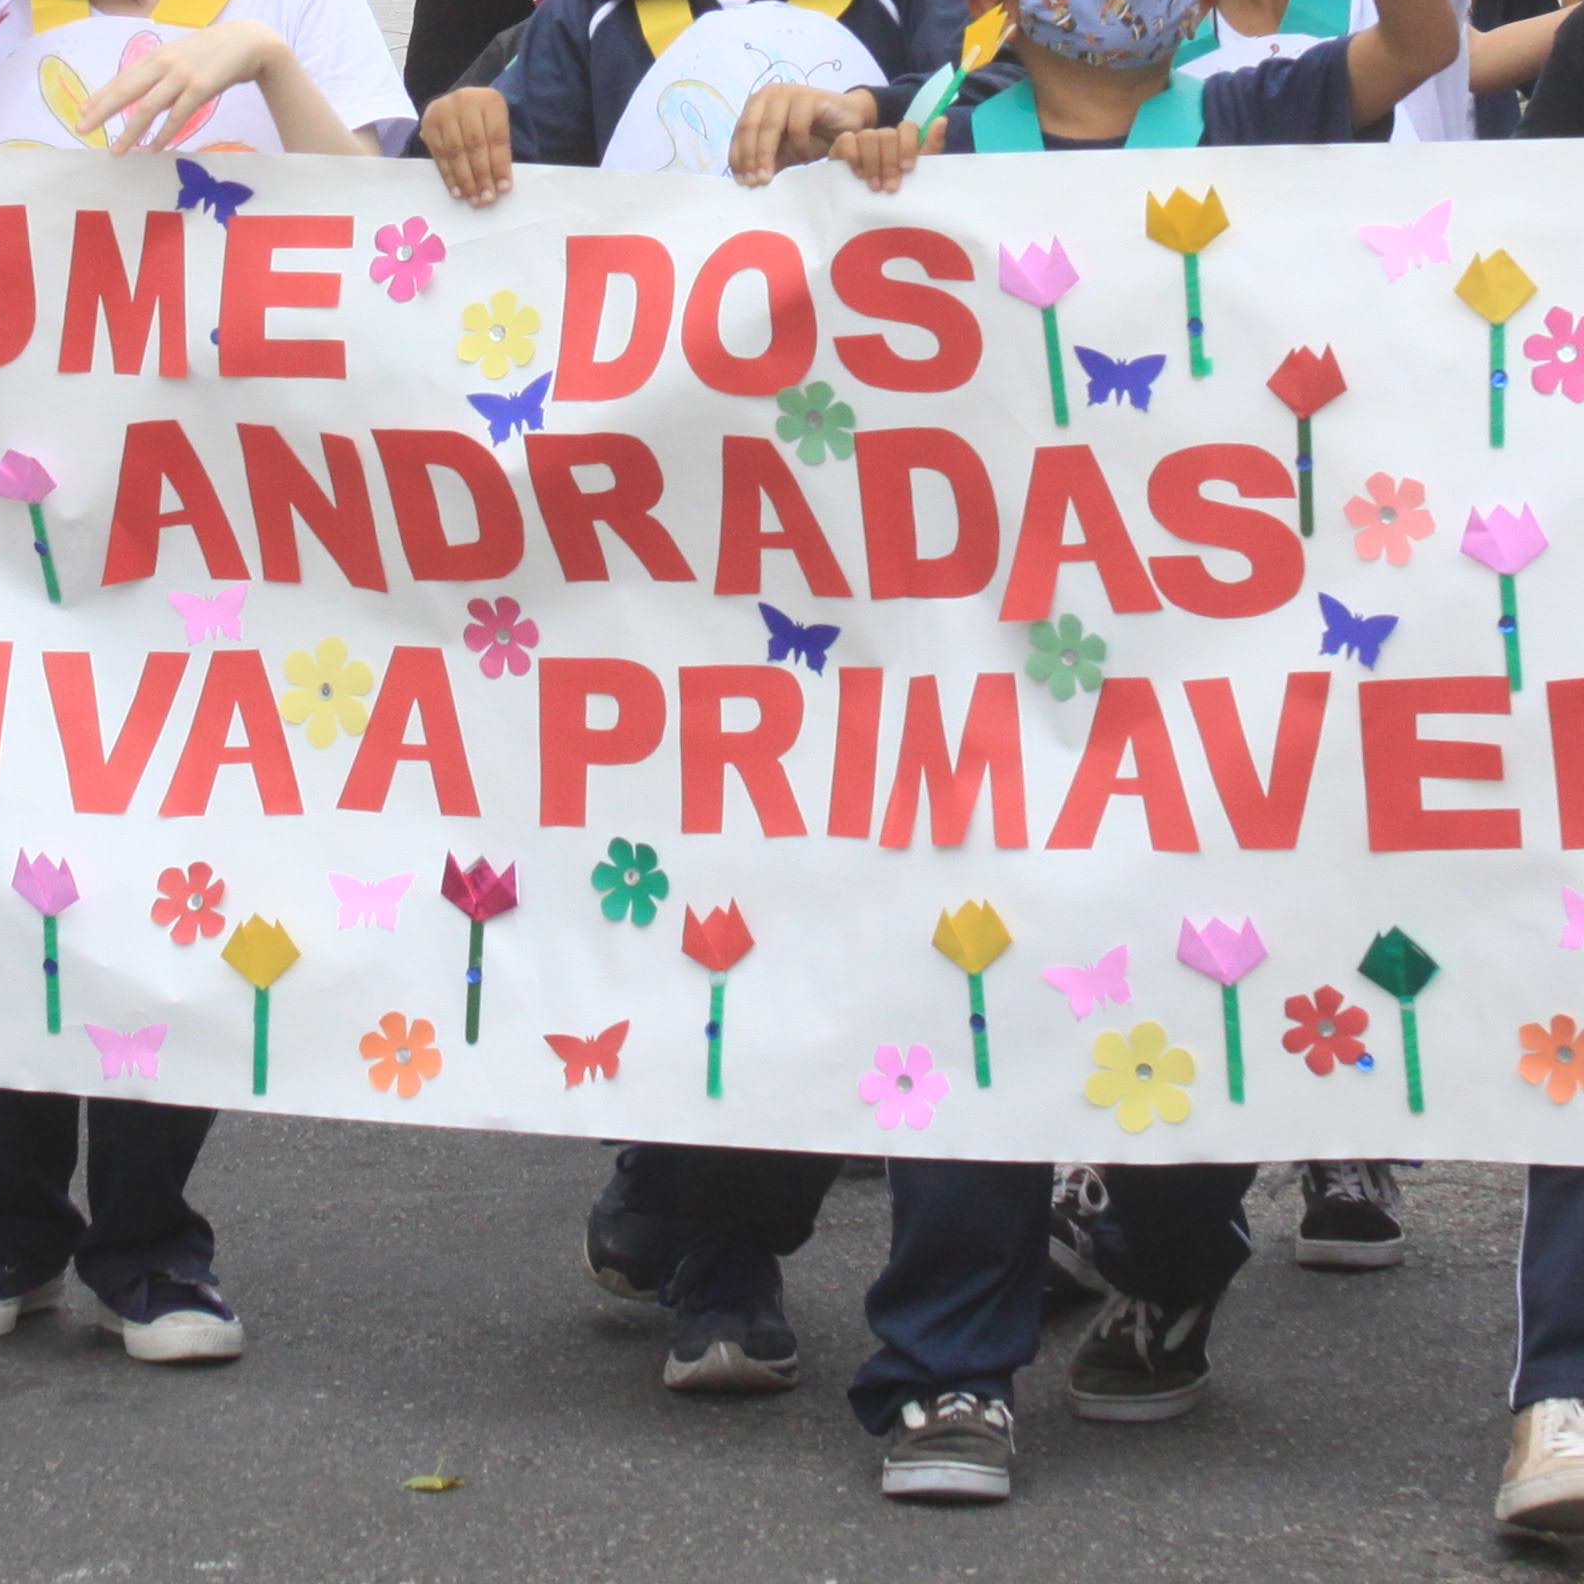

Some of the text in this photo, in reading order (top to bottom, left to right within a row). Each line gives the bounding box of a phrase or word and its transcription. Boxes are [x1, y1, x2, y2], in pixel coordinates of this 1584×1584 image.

[553, 227, 983, 401] DOS
[103, 419, 1305, 621] ANDRADAS
[340, 646, 479, 816] A
